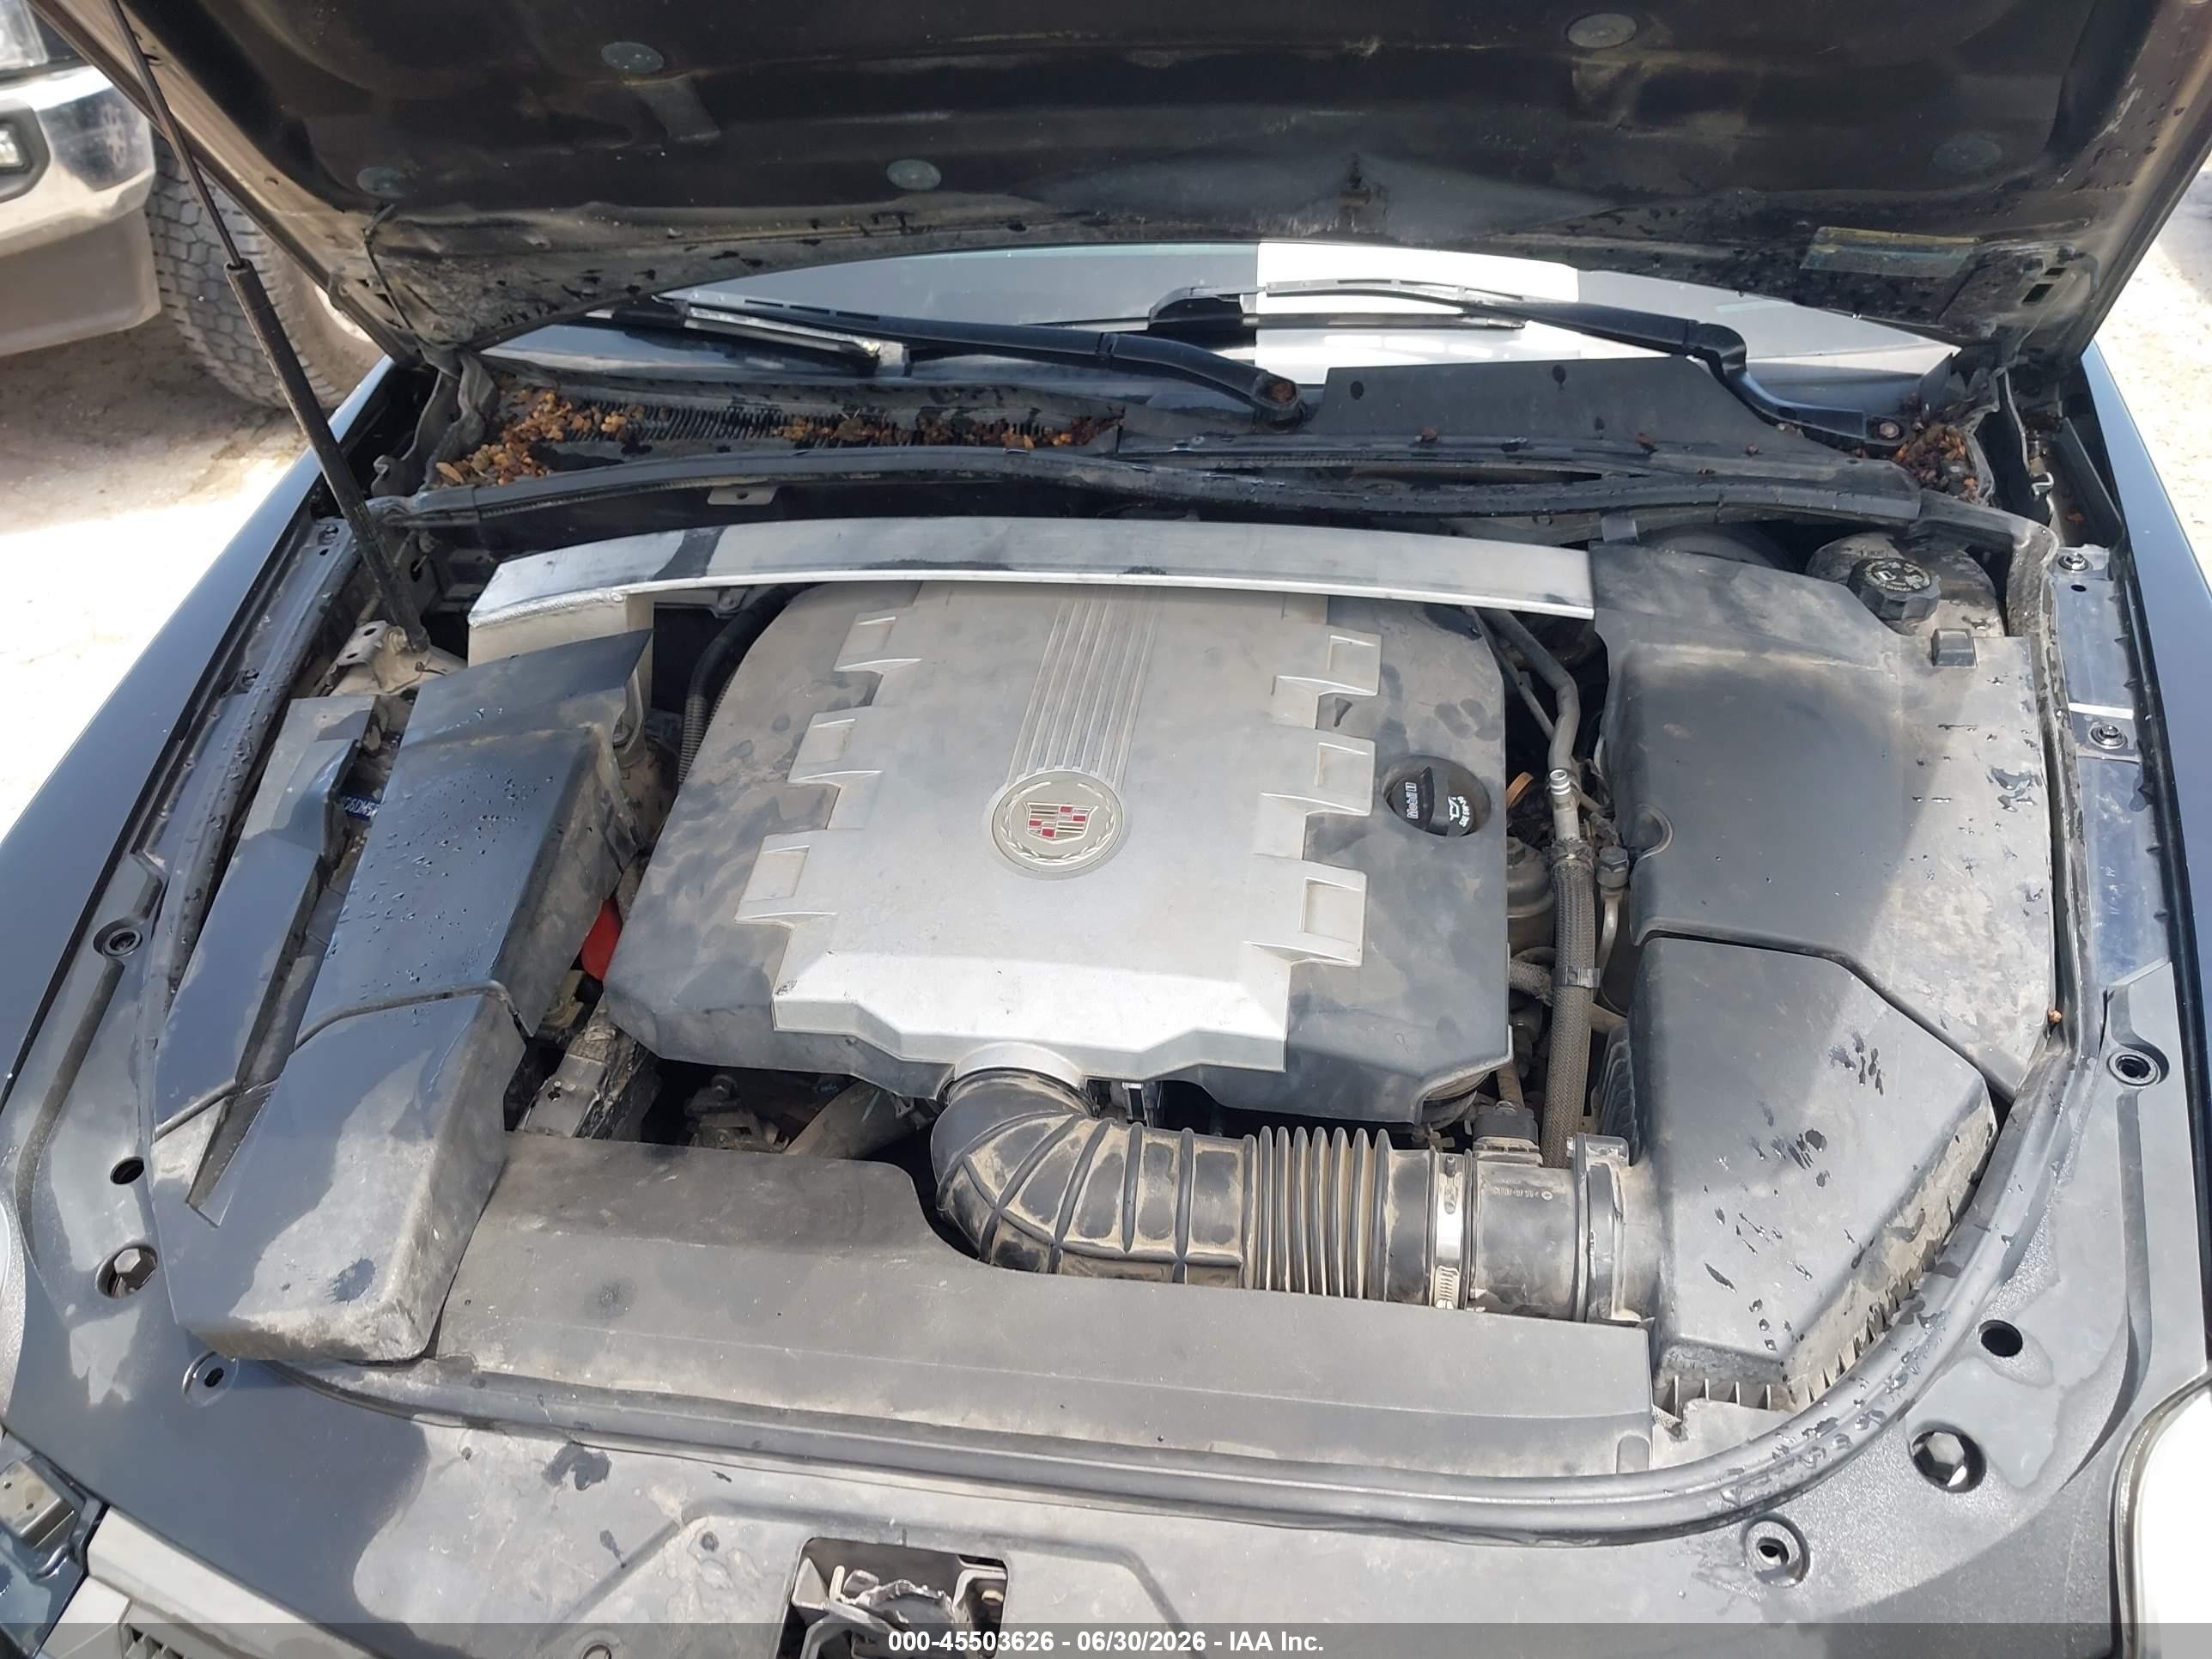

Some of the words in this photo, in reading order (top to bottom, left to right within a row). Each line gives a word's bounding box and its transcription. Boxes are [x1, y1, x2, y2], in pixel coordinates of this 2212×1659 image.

[1406, 781, 1418, 791] 1
[1407, 792, 1419, 818] Mobil
[1459, 816, 1470, 827] SAE
